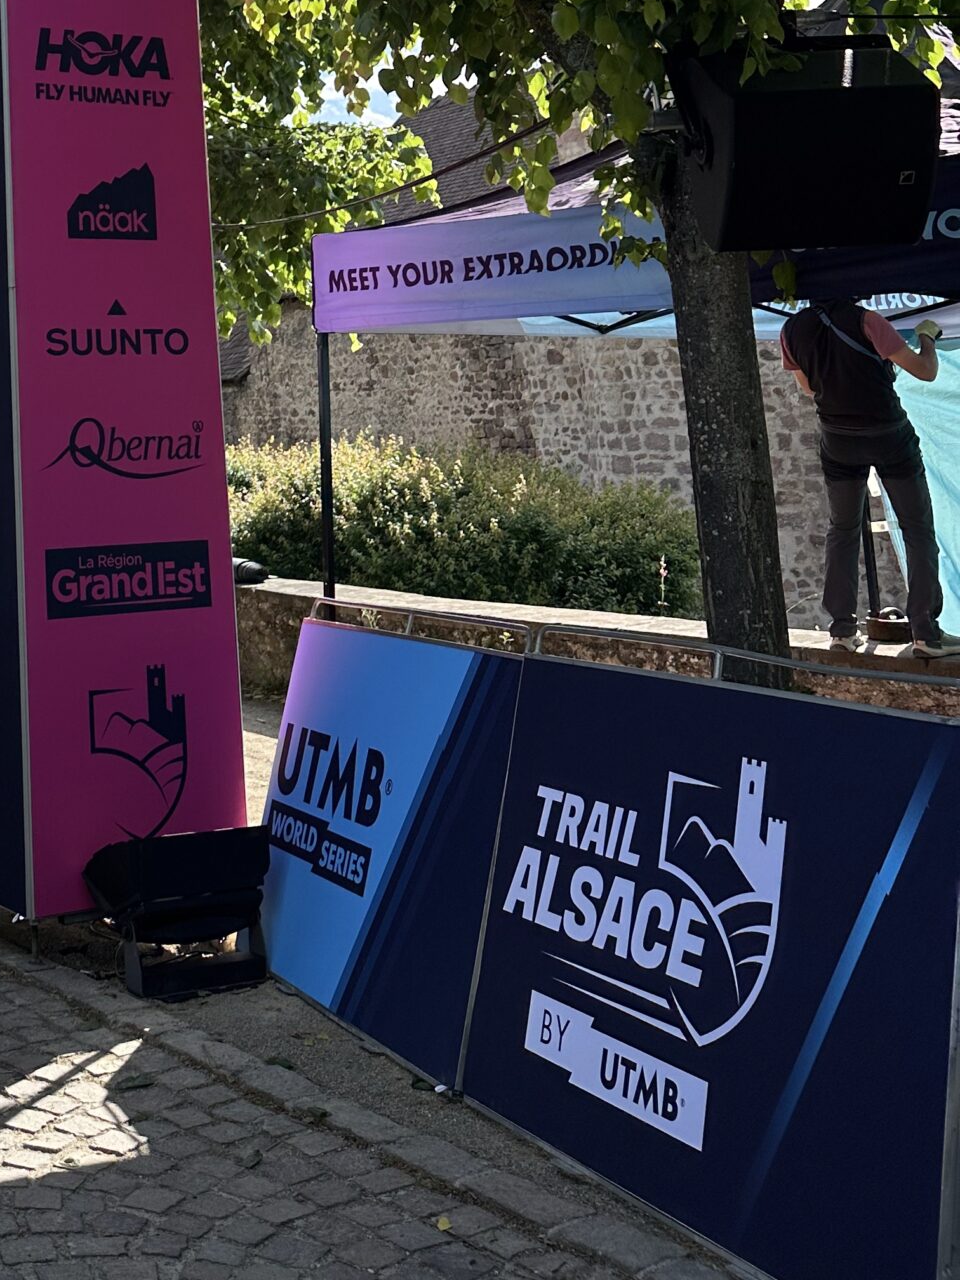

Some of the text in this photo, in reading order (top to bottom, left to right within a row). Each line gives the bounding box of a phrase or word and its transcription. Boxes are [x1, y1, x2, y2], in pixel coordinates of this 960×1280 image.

[35, 27, 170, 81] HOKA
[35, 82, 171, 107] FLY HUMAN FLY
[78, 204, 149, 233] näak
[328, 237, 663, 293] MEET YOUR EXTRAORDI
[45, 327, 189, 356] SUUNTO
[78, 553, 143, 570] La Région
[277, 722, 385, 827] UTMB
[271, 809, 365, 885] WORLD SERIES
[536, 784, 641, 867] TRAIL
[502, 845, 709, 988] ALSACE
[540, 1008, 680, 1122] BY UTMB
